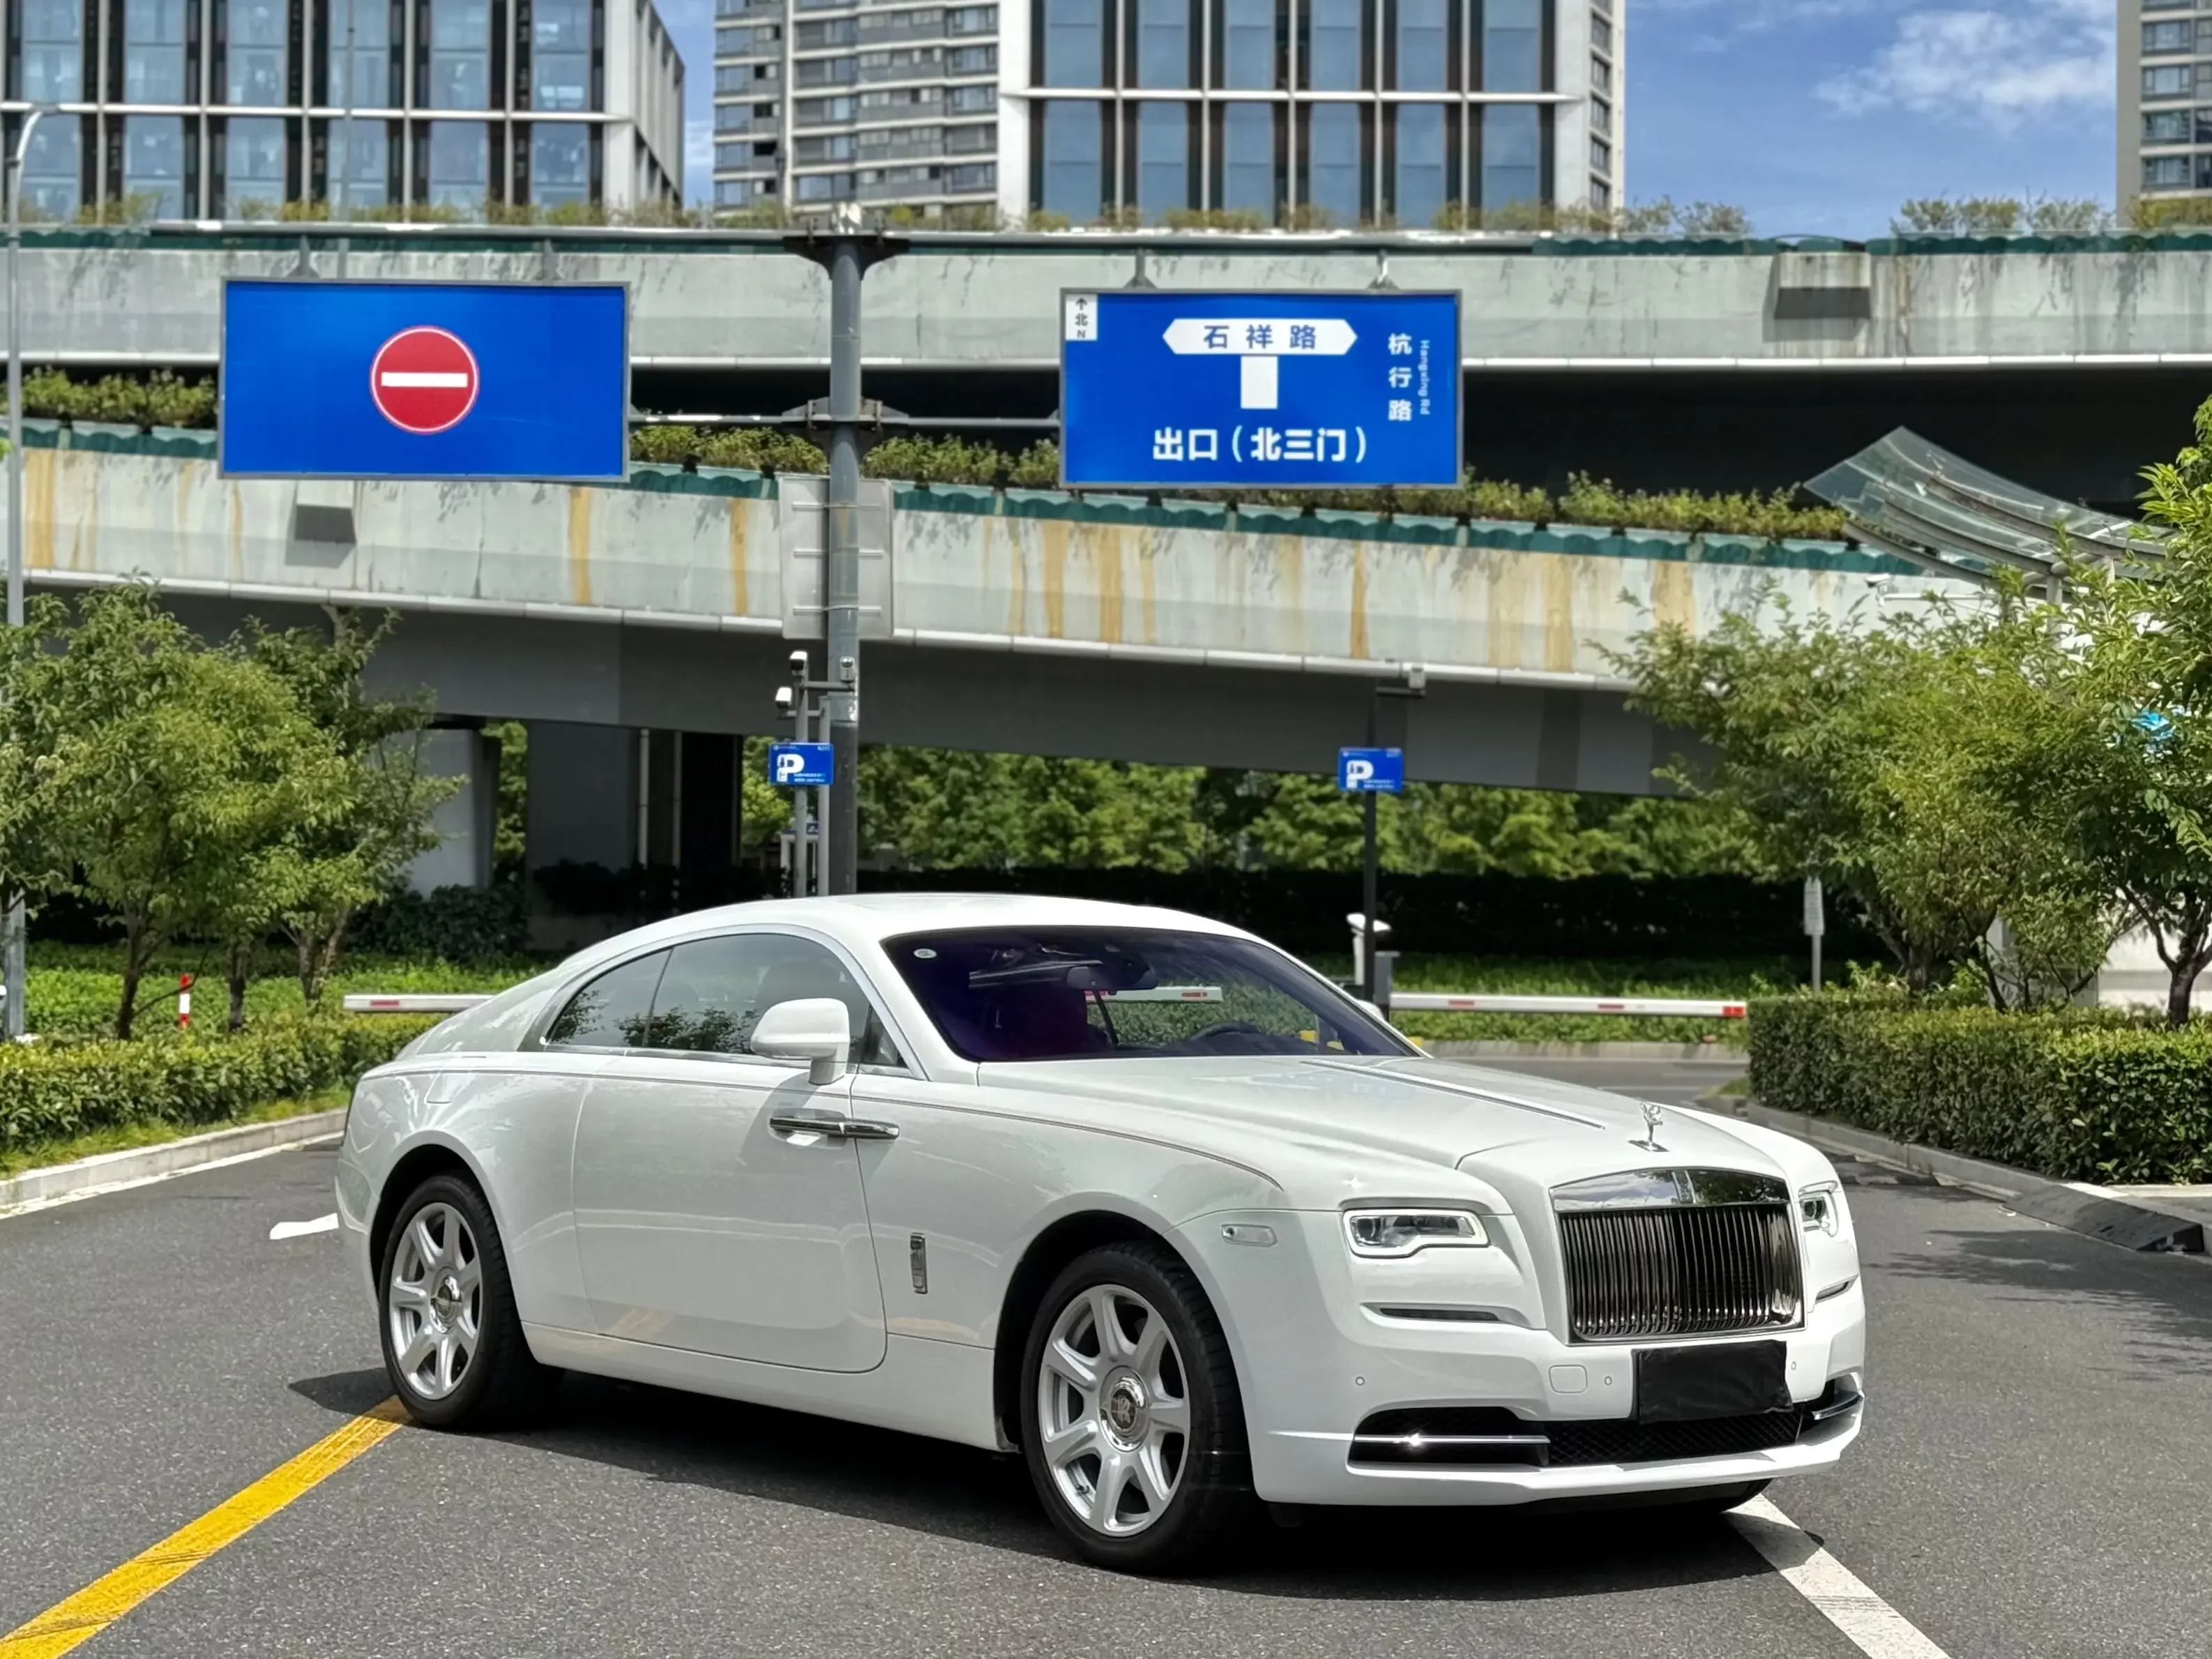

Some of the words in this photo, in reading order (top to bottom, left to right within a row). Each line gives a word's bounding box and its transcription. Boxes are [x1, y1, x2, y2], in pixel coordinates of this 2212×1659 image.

[1075, 312, 1089, 327] 北
[1077, 329, 1086, 339] N
[1203, 324, 1316, 350] 石祥路
[1388, 333, 1412, 421] 杭行路
[777, 754, 804, 782] P
[1347, 760, 1373, 788] P
